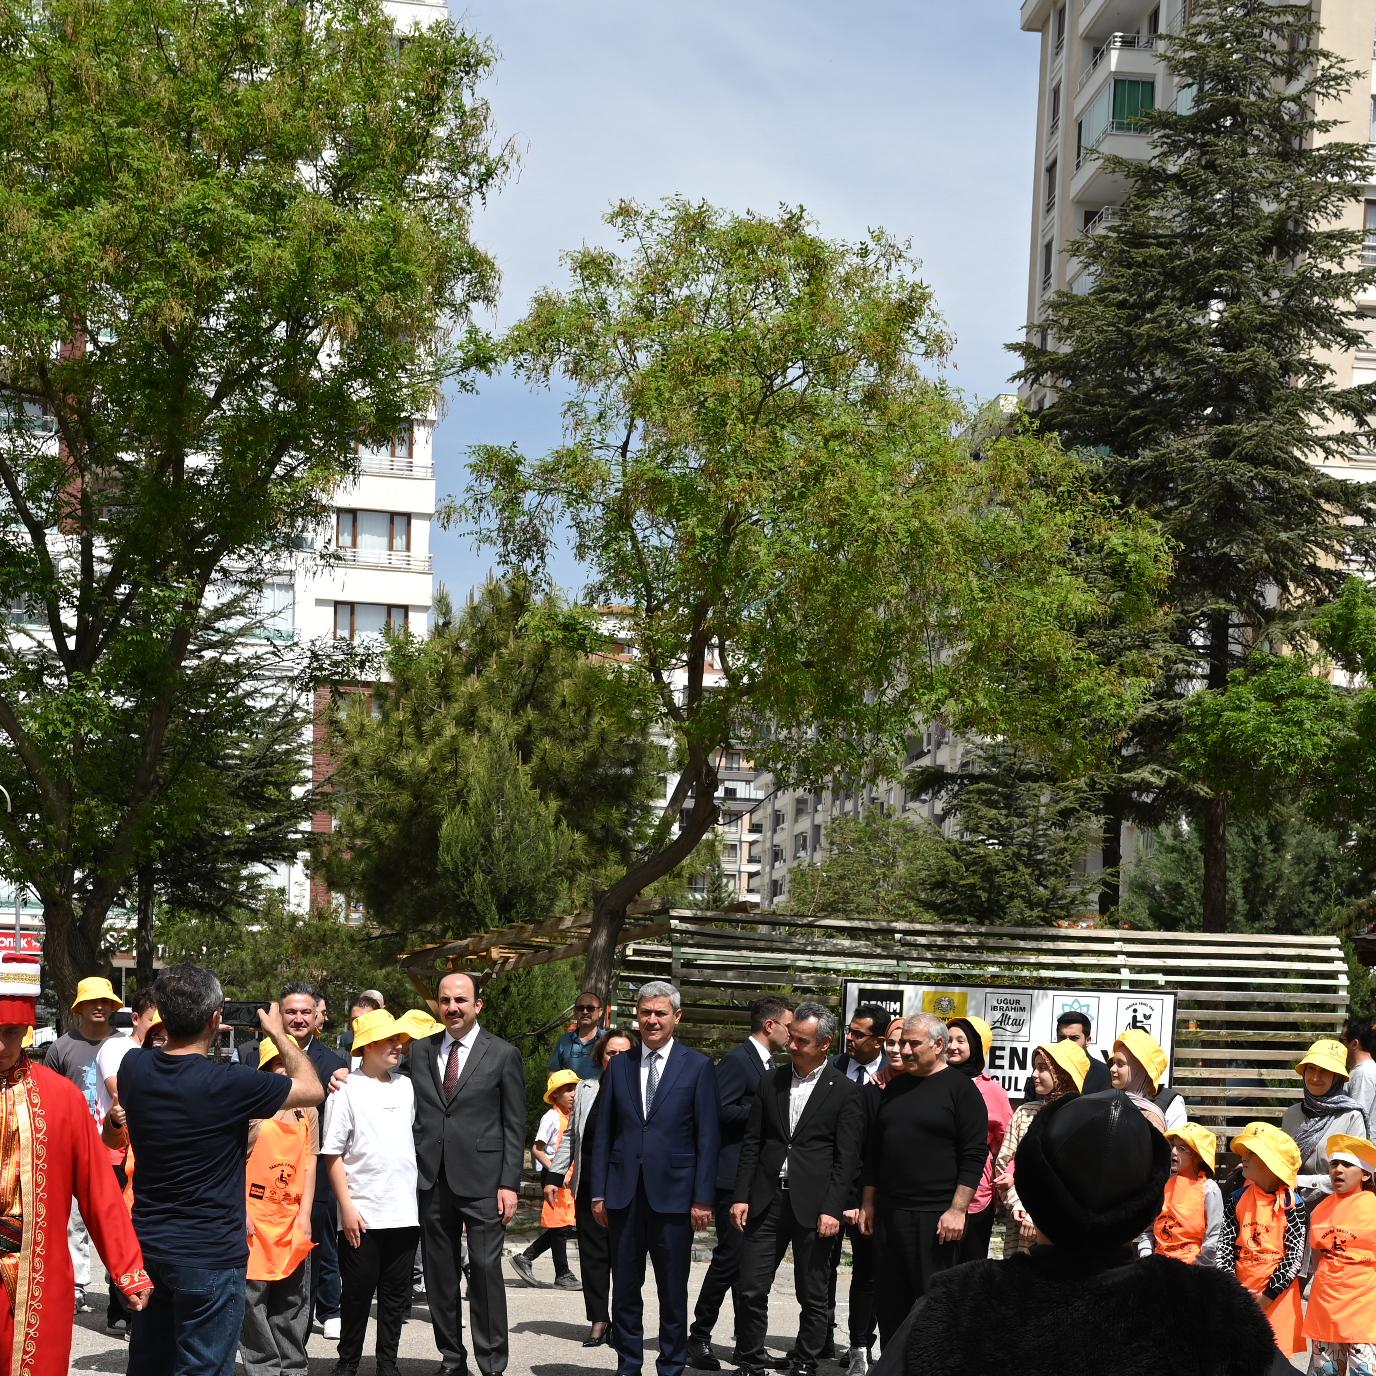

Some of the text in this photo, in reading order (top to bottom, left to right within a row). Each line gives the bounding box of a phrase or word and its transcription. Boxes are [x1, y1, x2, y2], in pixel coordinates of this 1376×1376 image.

[996, 998, 1021, 1006] UĞUR
[990, 1005, 1026, 1013] İBRAHİM
[991, 1012, 1026, 1029] Altay
